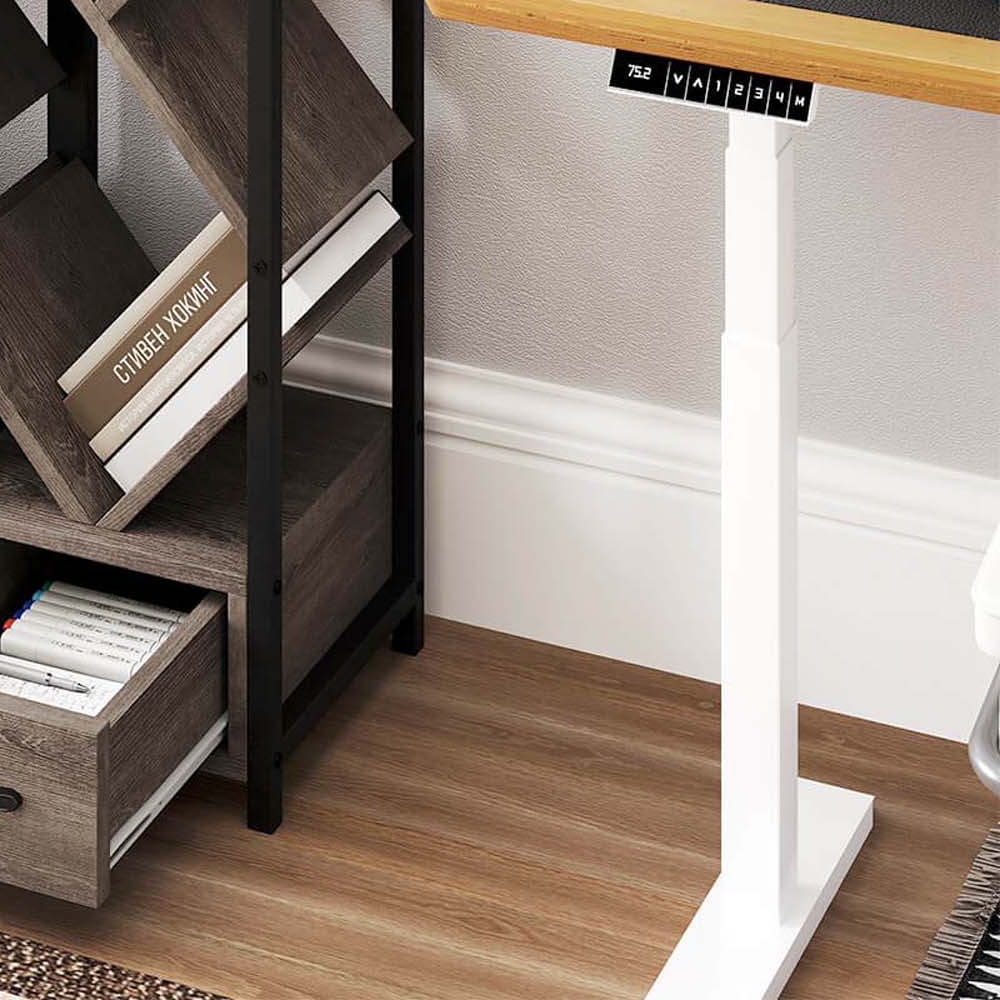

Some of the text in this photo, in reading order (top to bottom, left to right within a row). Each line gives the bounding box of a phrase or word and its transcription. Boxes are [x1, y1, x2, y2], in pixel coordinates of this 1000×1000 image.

[734, 84, 744, 96] 2
[753, 87, 764, 100] 3
[775, 91, 785, 103] 4
[794, 96, 805, 107] M
[112, 322, 170, 386] СТИВЕН
[162, 271, 220, 333] ХОКИНГ
